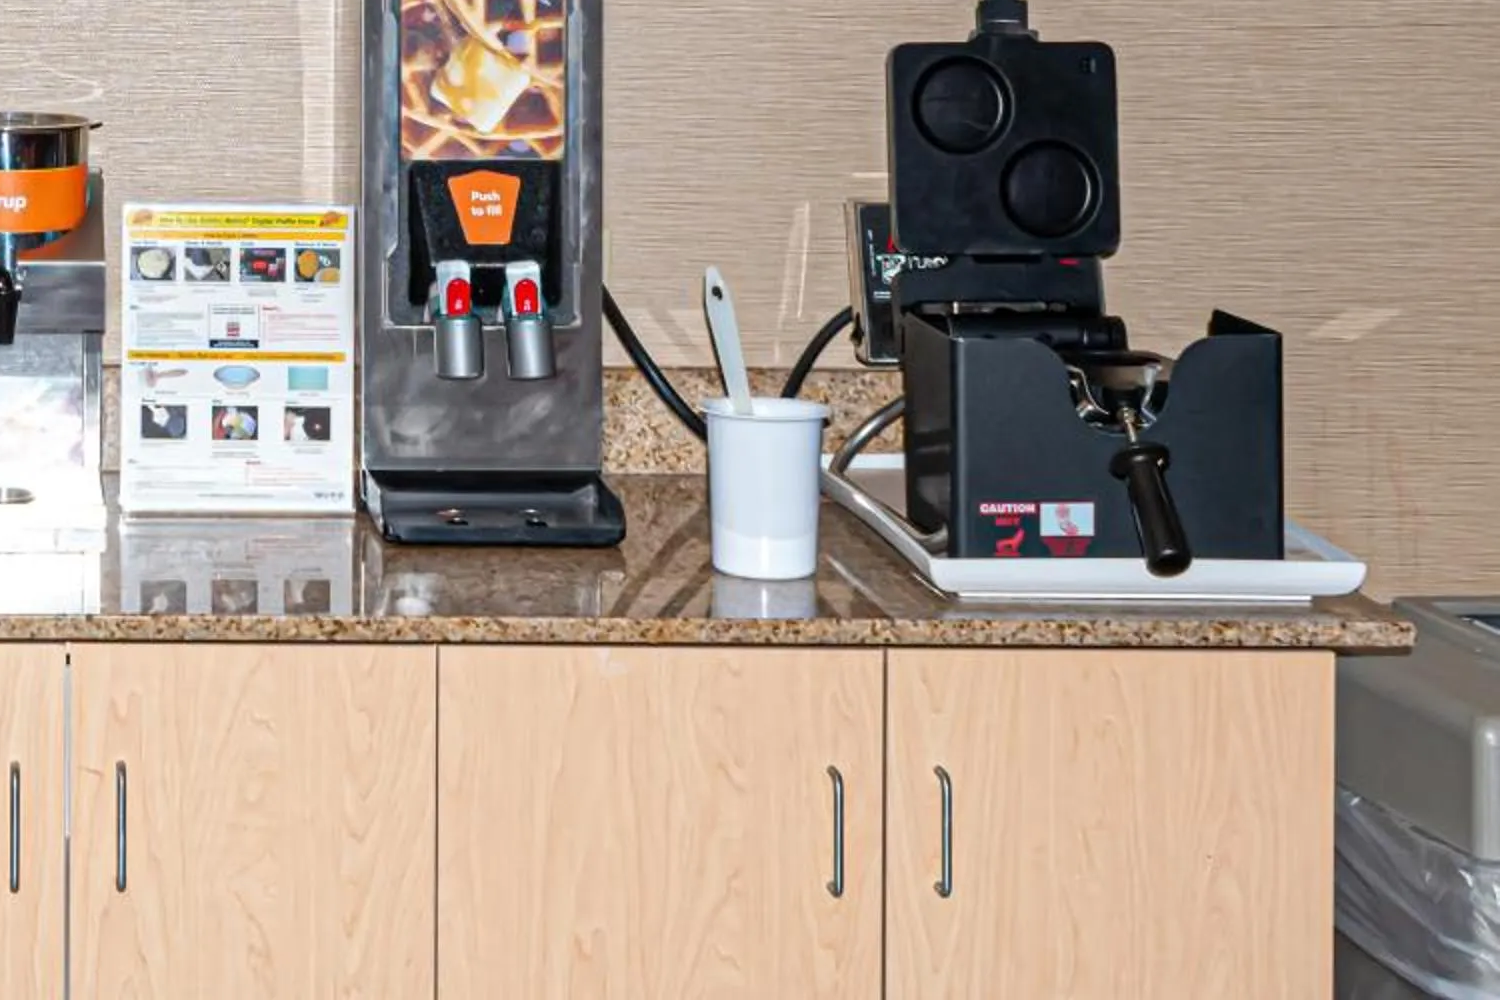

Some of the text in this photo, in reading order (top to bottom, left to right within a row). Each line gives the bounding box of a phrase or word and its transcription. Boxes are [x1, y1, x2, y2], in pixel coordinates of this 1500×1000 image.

[470, 189, 501, 202] Push
[470, 204, 503, 217] to fill
[979, 502, 1037, 514] CAUTION
